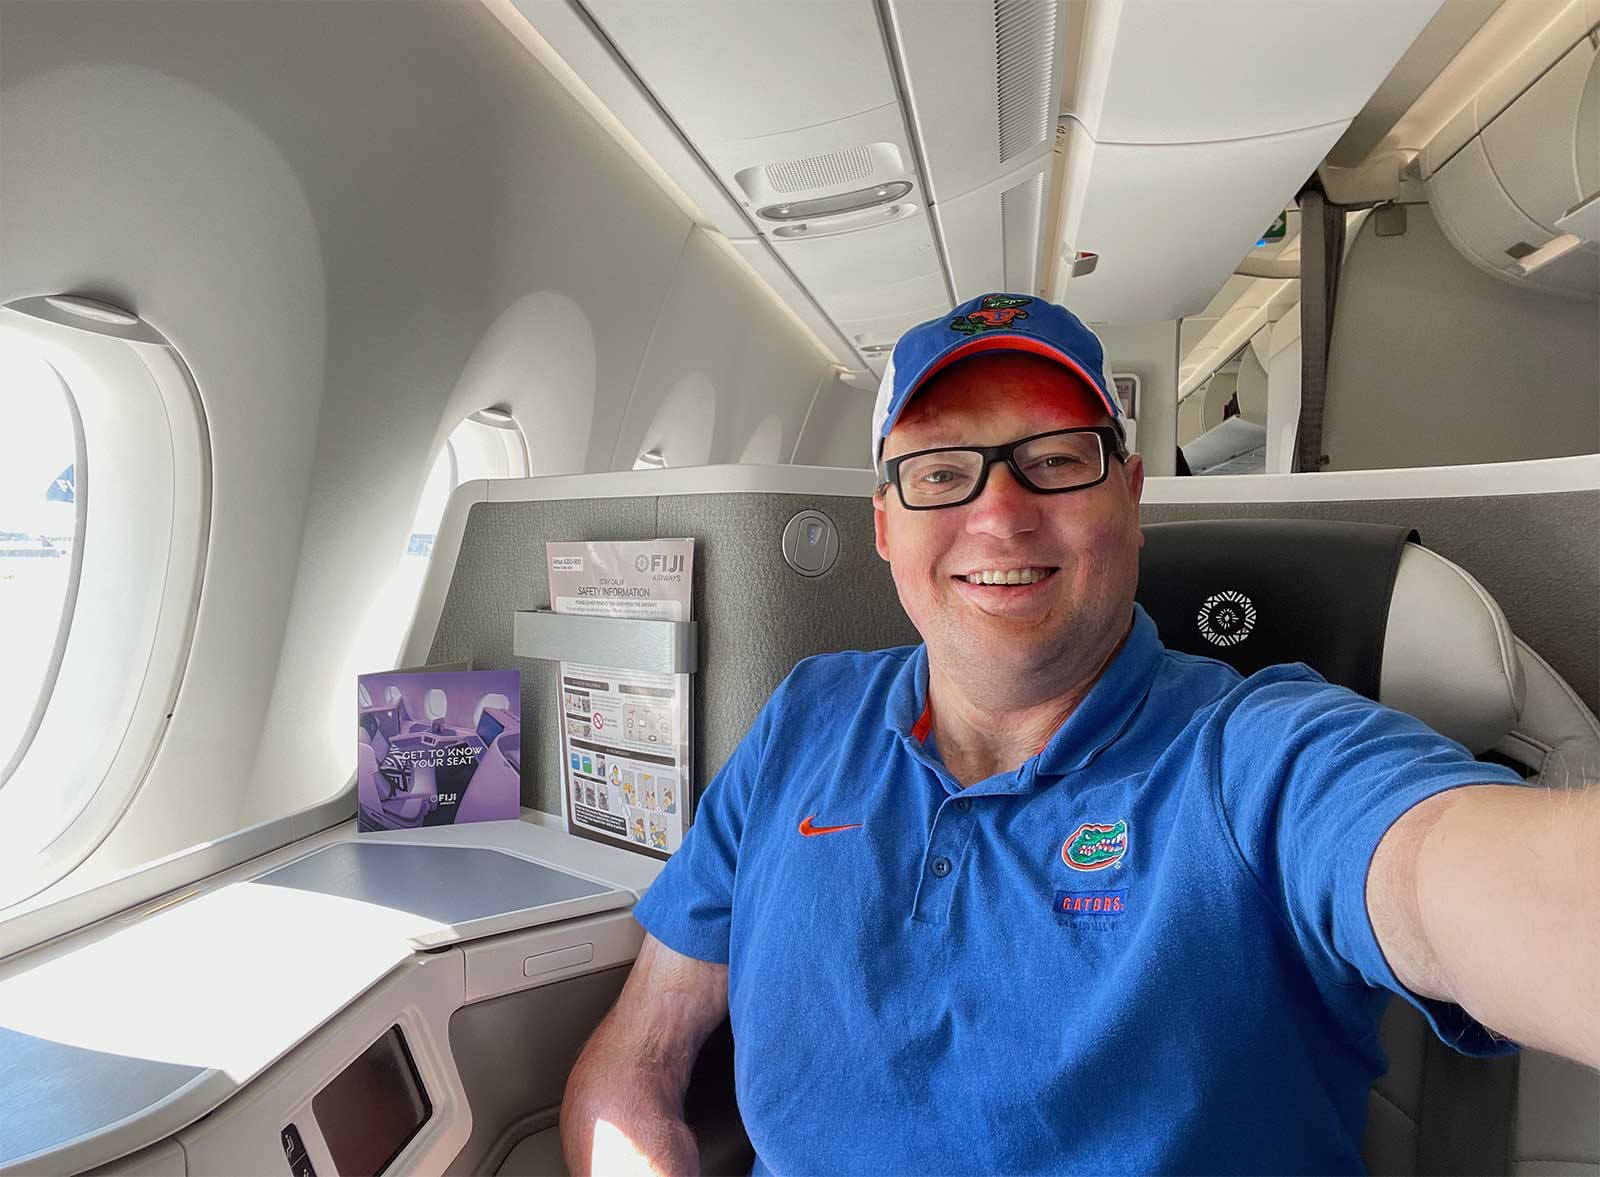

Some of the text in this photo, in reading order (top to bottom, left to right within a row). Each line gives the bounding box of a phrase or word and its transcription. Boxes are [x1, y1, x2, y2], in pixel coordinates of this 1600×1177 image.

[651, 554, 685, 573] FIJI
[652, 574, 681, 582] AIRWAYS
[577, 586, 650, 598] SAFETY INFORMATION
[402, 746, 483, 760] GET TO KNOW
[411, 755, 475, 768] YOUR SEAT
[438, 793, 457, 802] FIJI
